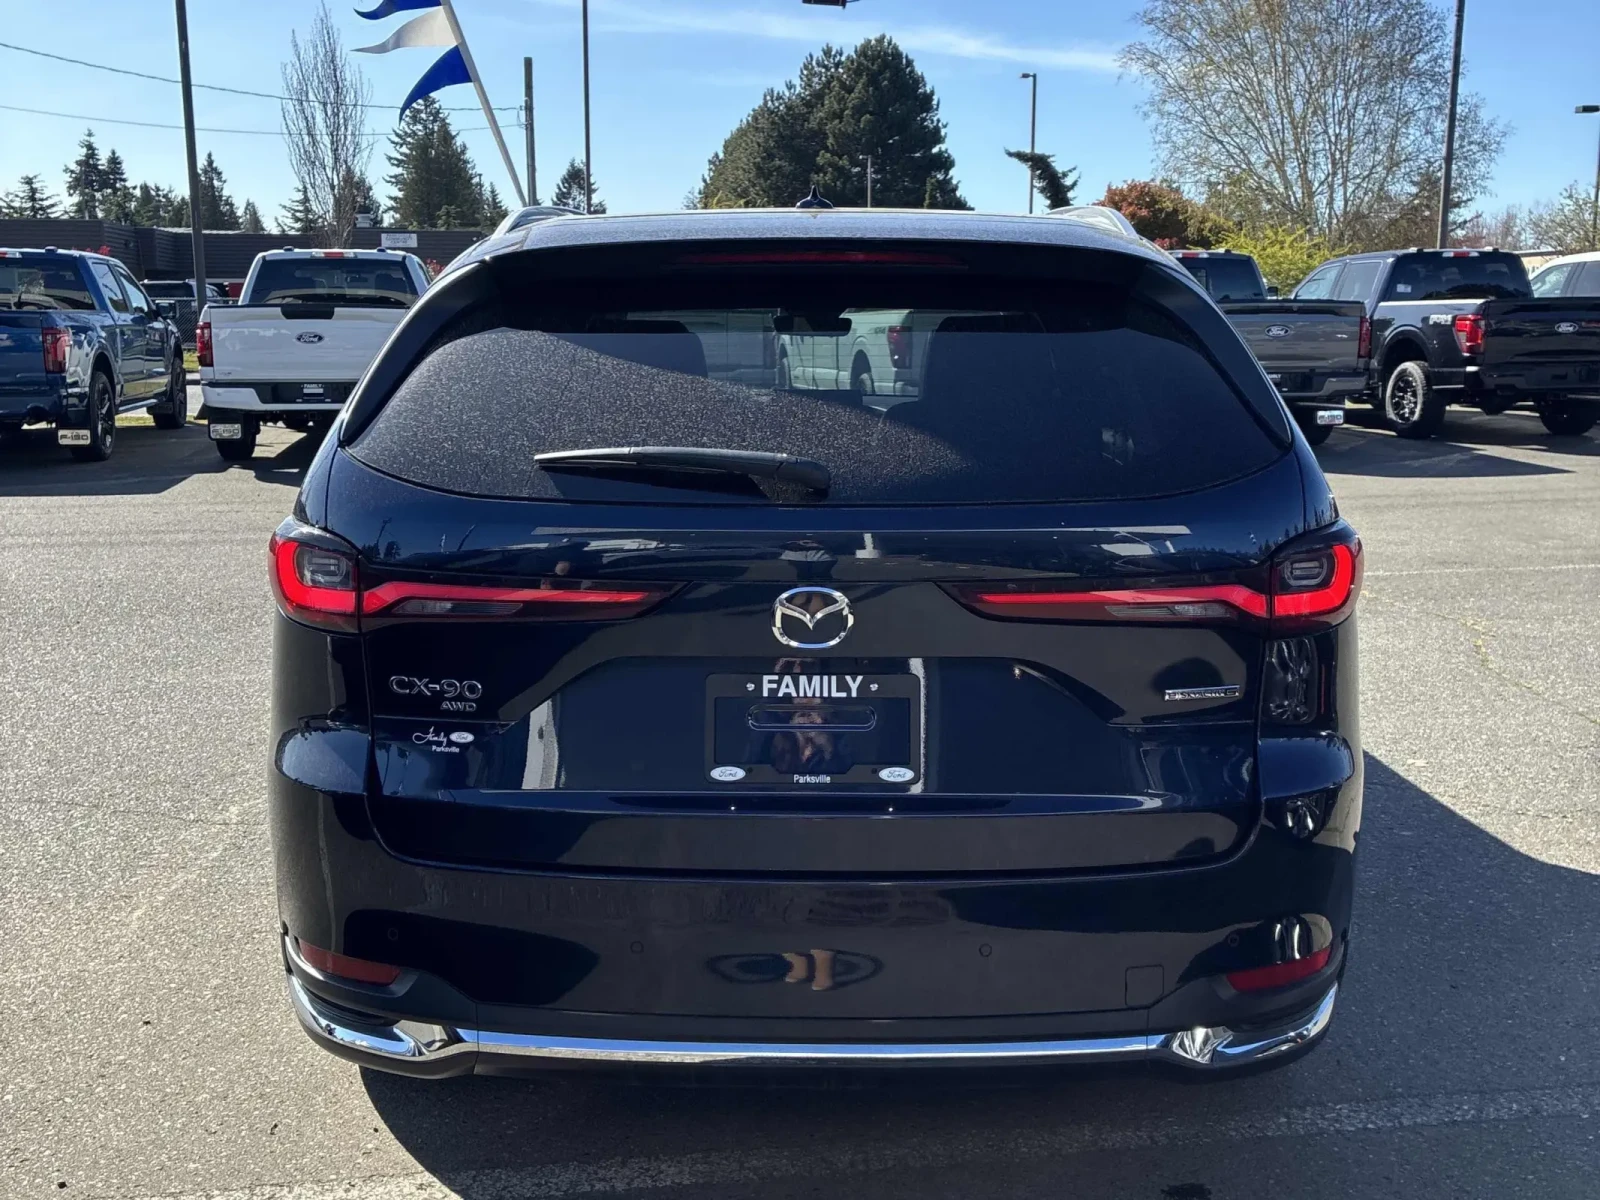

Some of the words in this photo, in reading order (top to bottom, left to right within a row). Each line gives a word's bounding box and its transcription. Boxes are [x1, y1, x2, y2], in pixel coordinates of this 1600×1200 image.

[388, 675, 482, 699] CX-90
[762, 675, 863, 698] FAMILY
[440, 700, 477, 712] AWD
[431, 745, 460, 753] Parksville
[716, 767, 740, 778] Ford
[884, 767, 909, 779] Ford
[793, 774, 831, 784] Parksville
